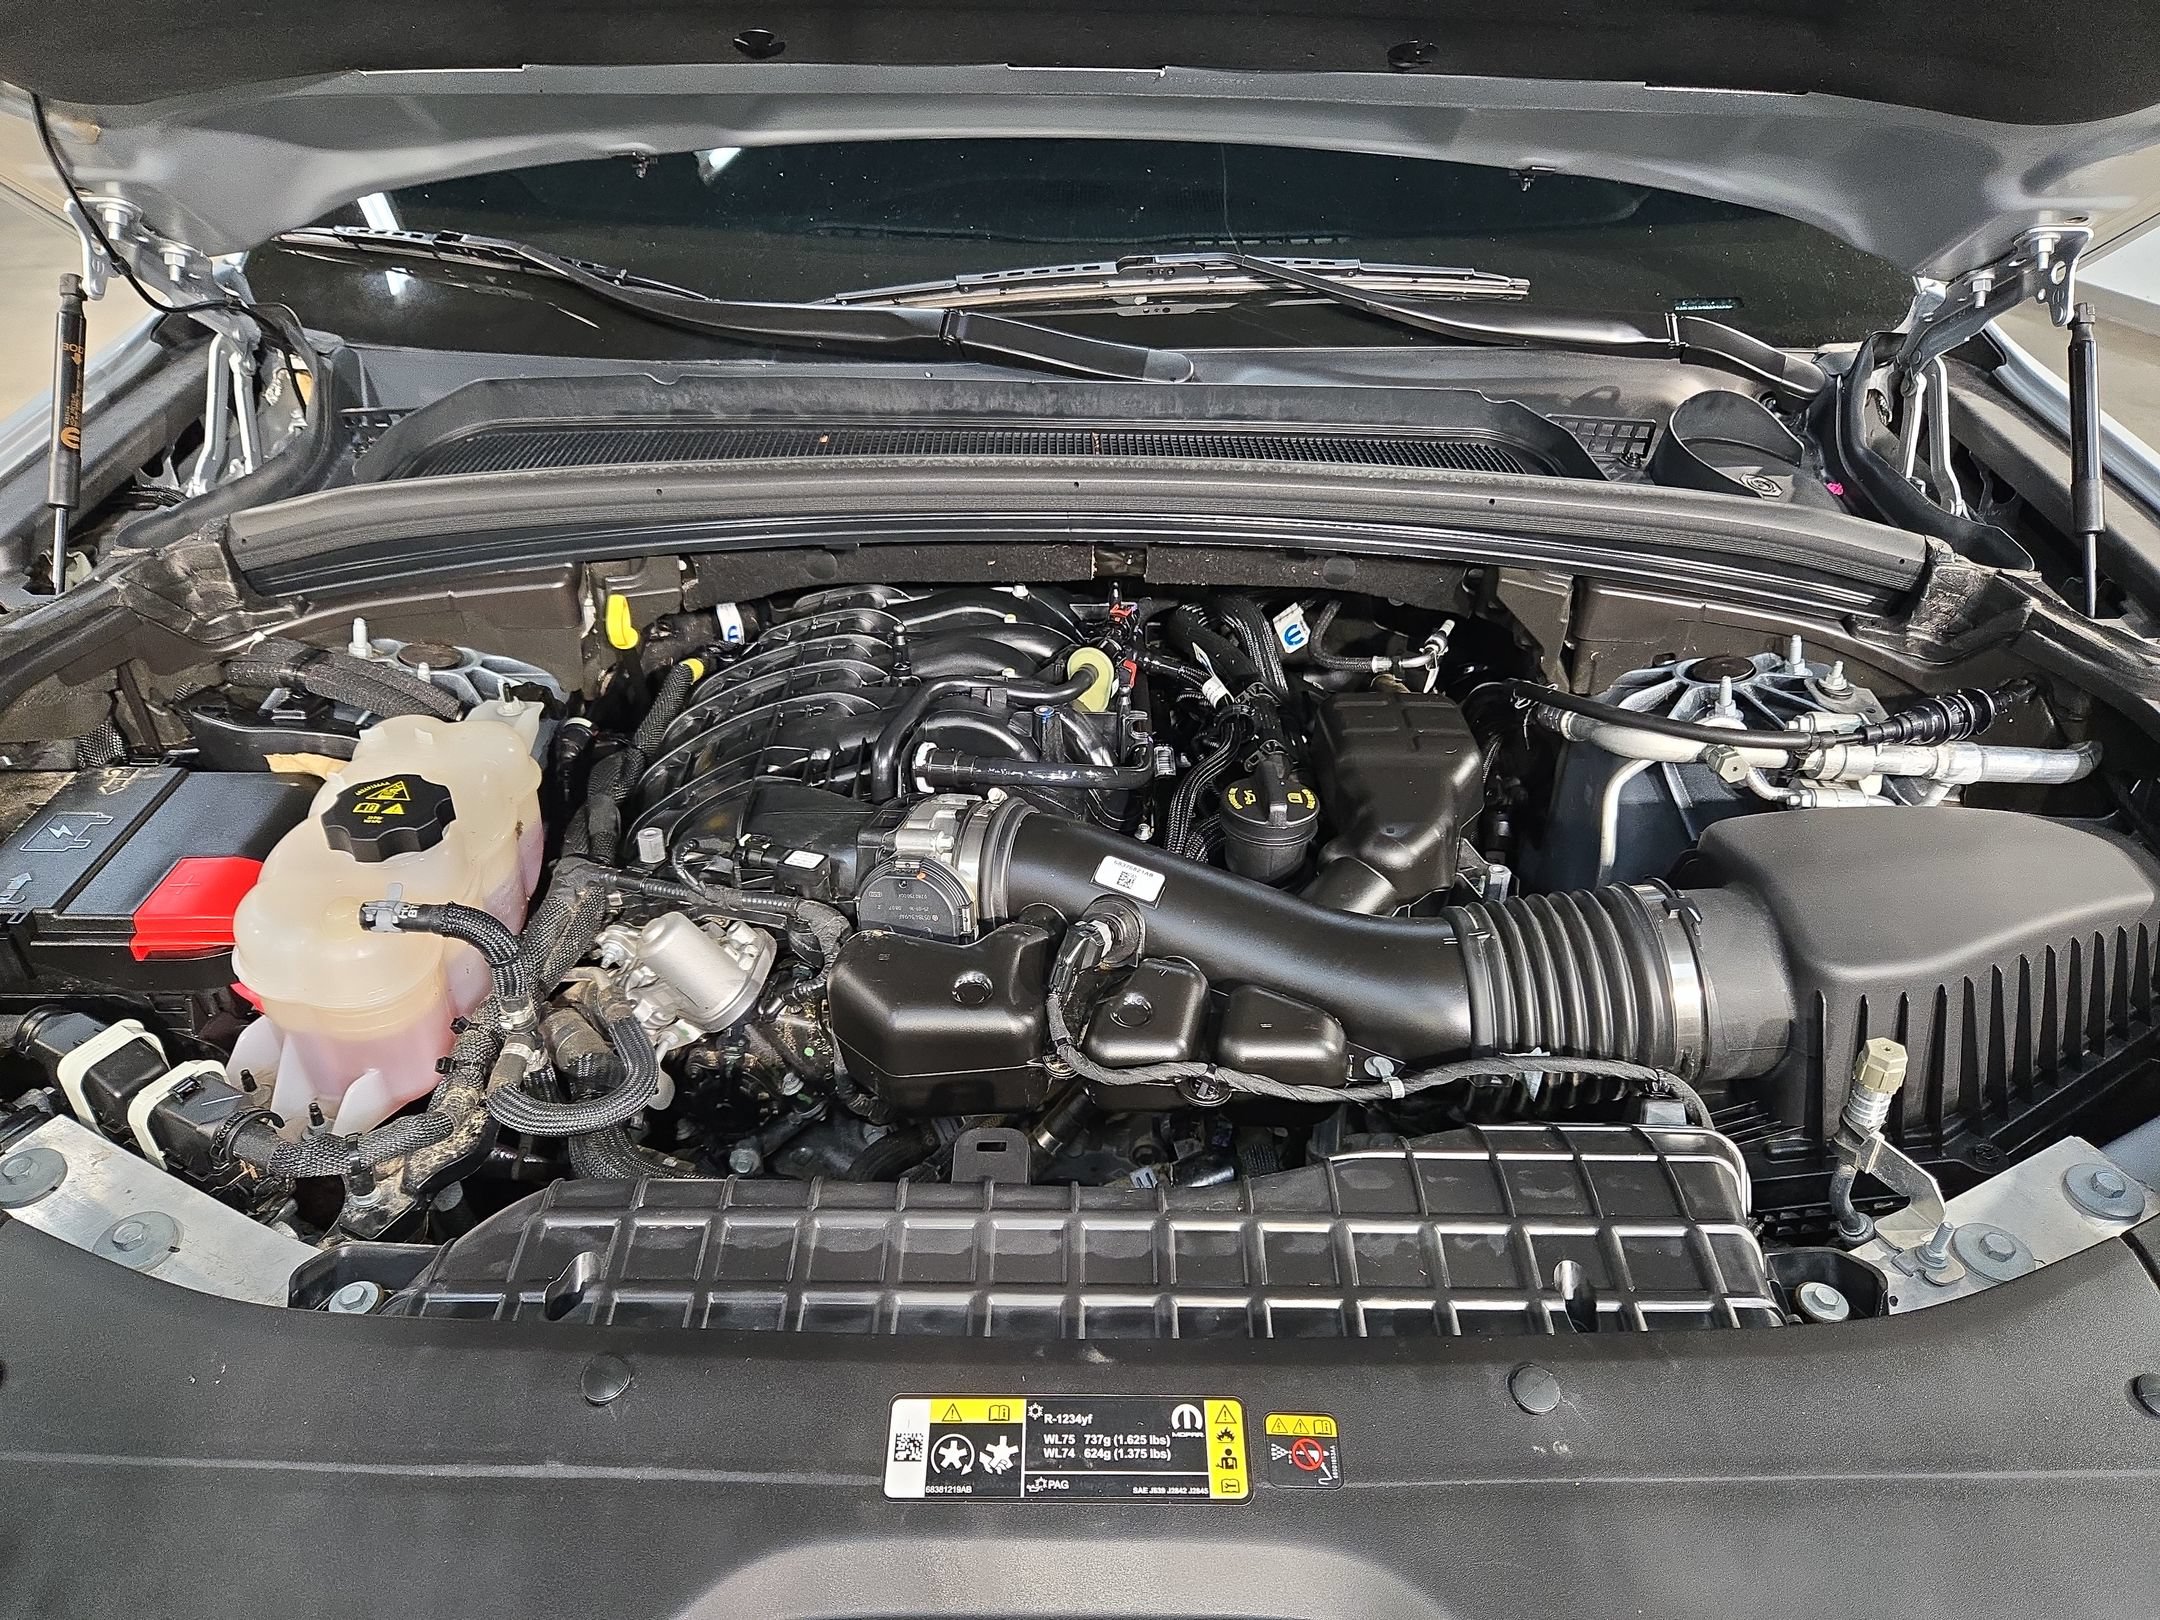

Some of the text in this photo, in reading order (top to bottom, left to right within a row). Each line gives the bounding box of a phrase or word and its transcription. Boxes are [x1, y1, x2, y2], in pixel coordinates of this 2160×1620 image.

[1043, 1413, 1094, 1427] R-1234yf
[1043, 1433, 1171, 1448] WL75 737g (1.625 lbs)
[1043, 1447, 1172, 1462] WL74 624g (1.375 lbs)
[1047, 1479, 1070, 1490] PAG
[1132, 1486, 1149, 1494] SAE
